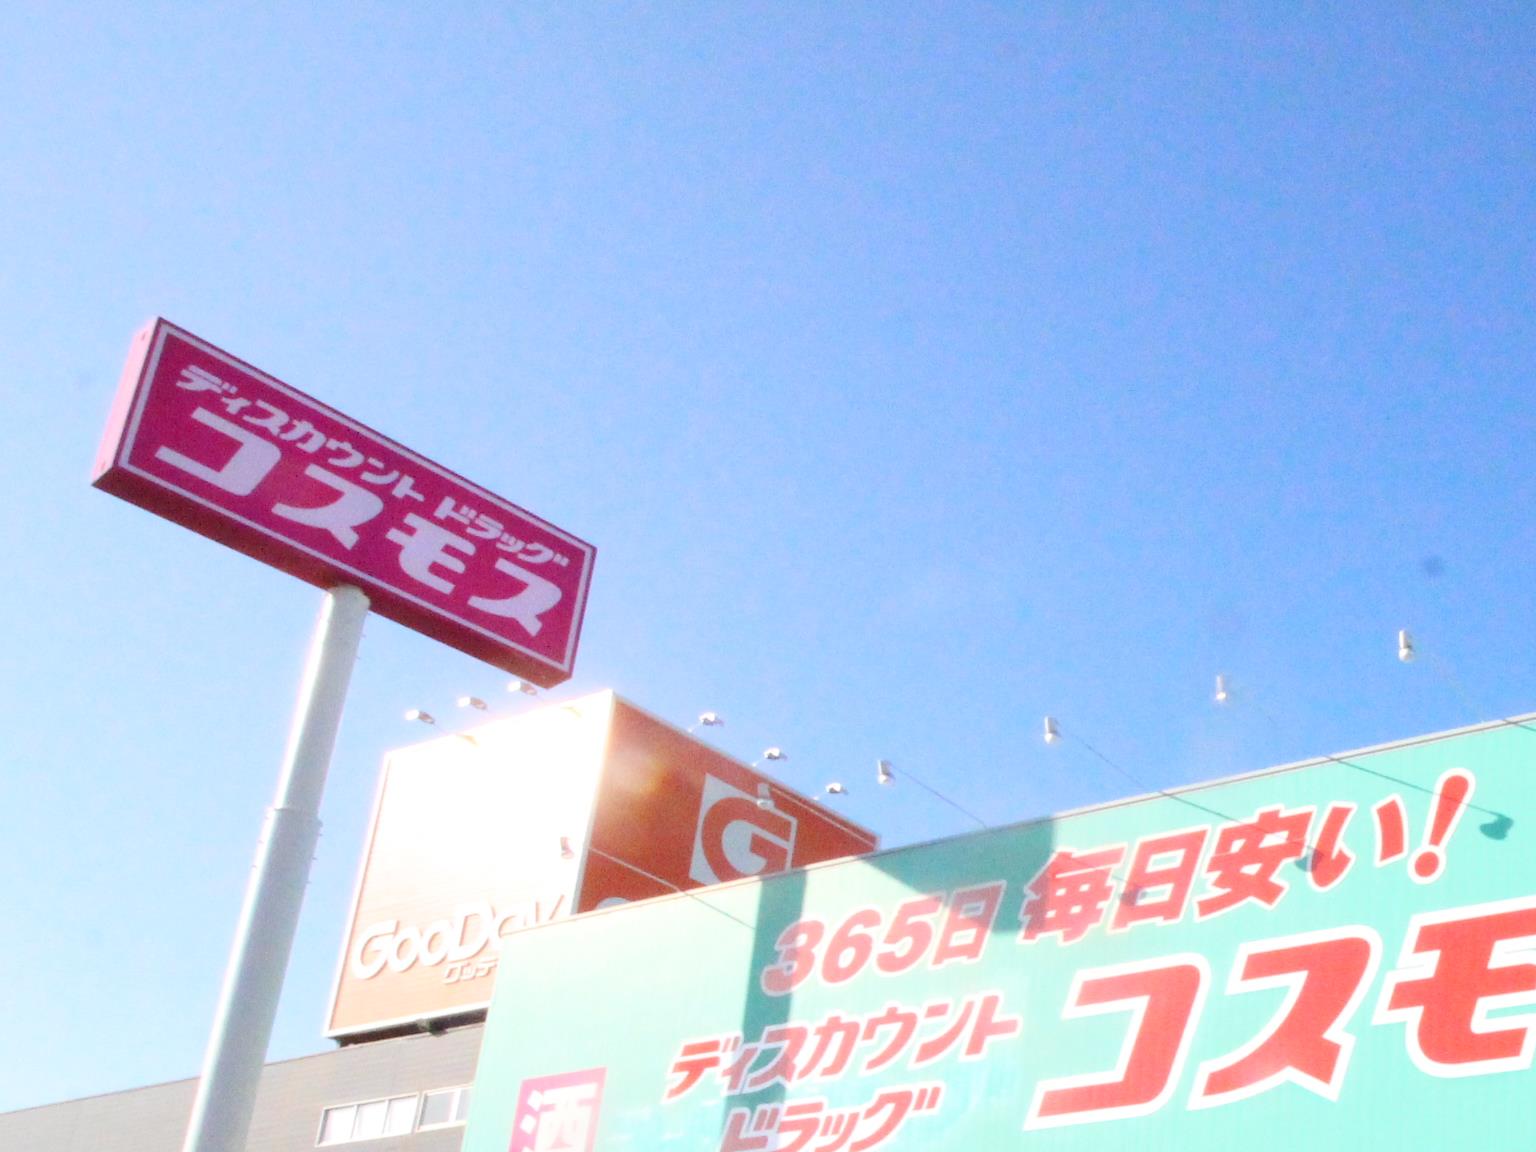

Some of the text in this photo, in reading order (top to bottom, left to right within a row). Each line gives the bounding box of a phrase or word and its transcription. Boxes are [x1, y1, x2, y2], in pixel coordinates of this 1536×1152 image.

[155, 406, 563, 637] コスモス
[176, 364, 569, 567] ディスカウント ドラッグ
[761, 767, 1476, 997] 365日 毎日安い!
[665, 992, 1020, 1102] ディスカウント
